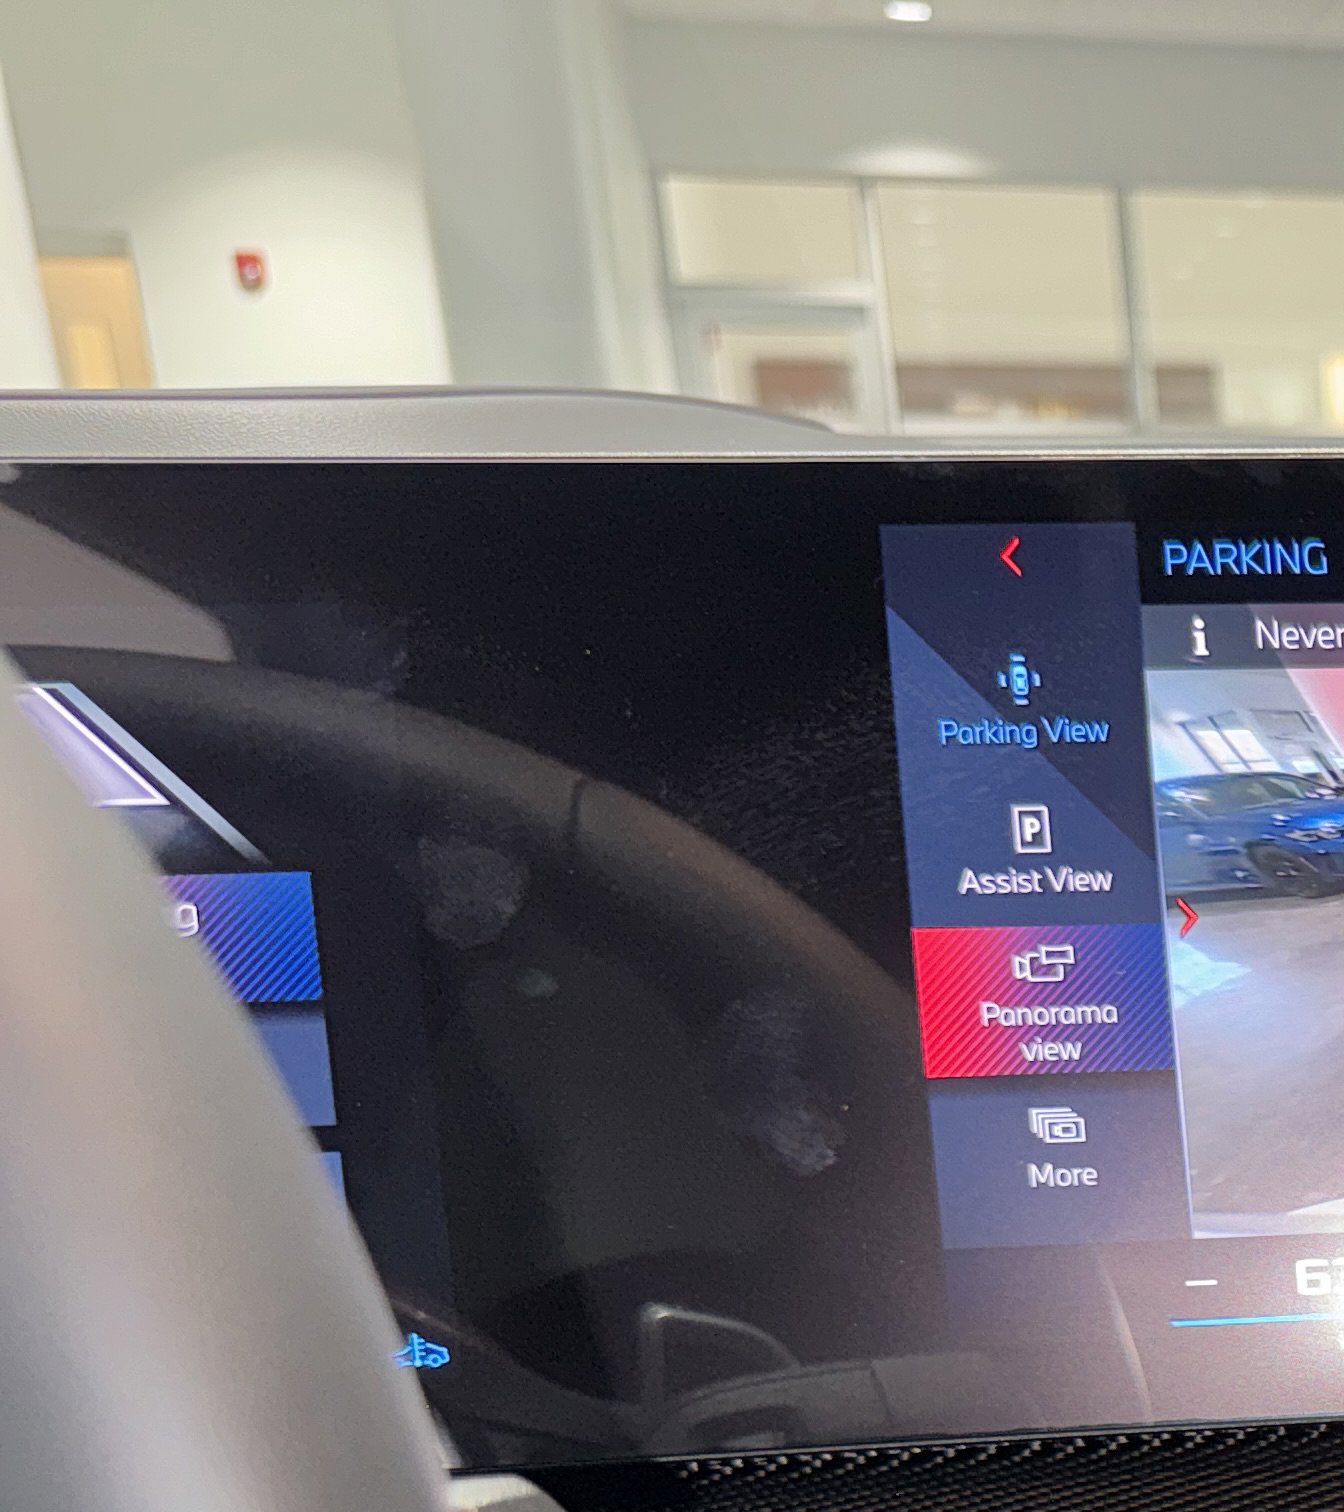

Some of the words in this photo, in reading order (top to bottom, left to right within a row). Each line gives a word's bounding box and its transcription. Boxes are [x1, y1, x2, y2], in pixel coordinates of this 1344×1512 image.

[1162, 538, 1329, 576] PARKING
[938, 717, 1038, 749] Parking
[1040, 715, 1110, 745] View
[957, 865, 1044, 896] Assist
[1045, 865, 1113, 895] View
[978, 1000, 1118, 1028] Panorama
[1019, 1038, 1083, 1062] view
[1026, 1162, 1098, 1189] More
